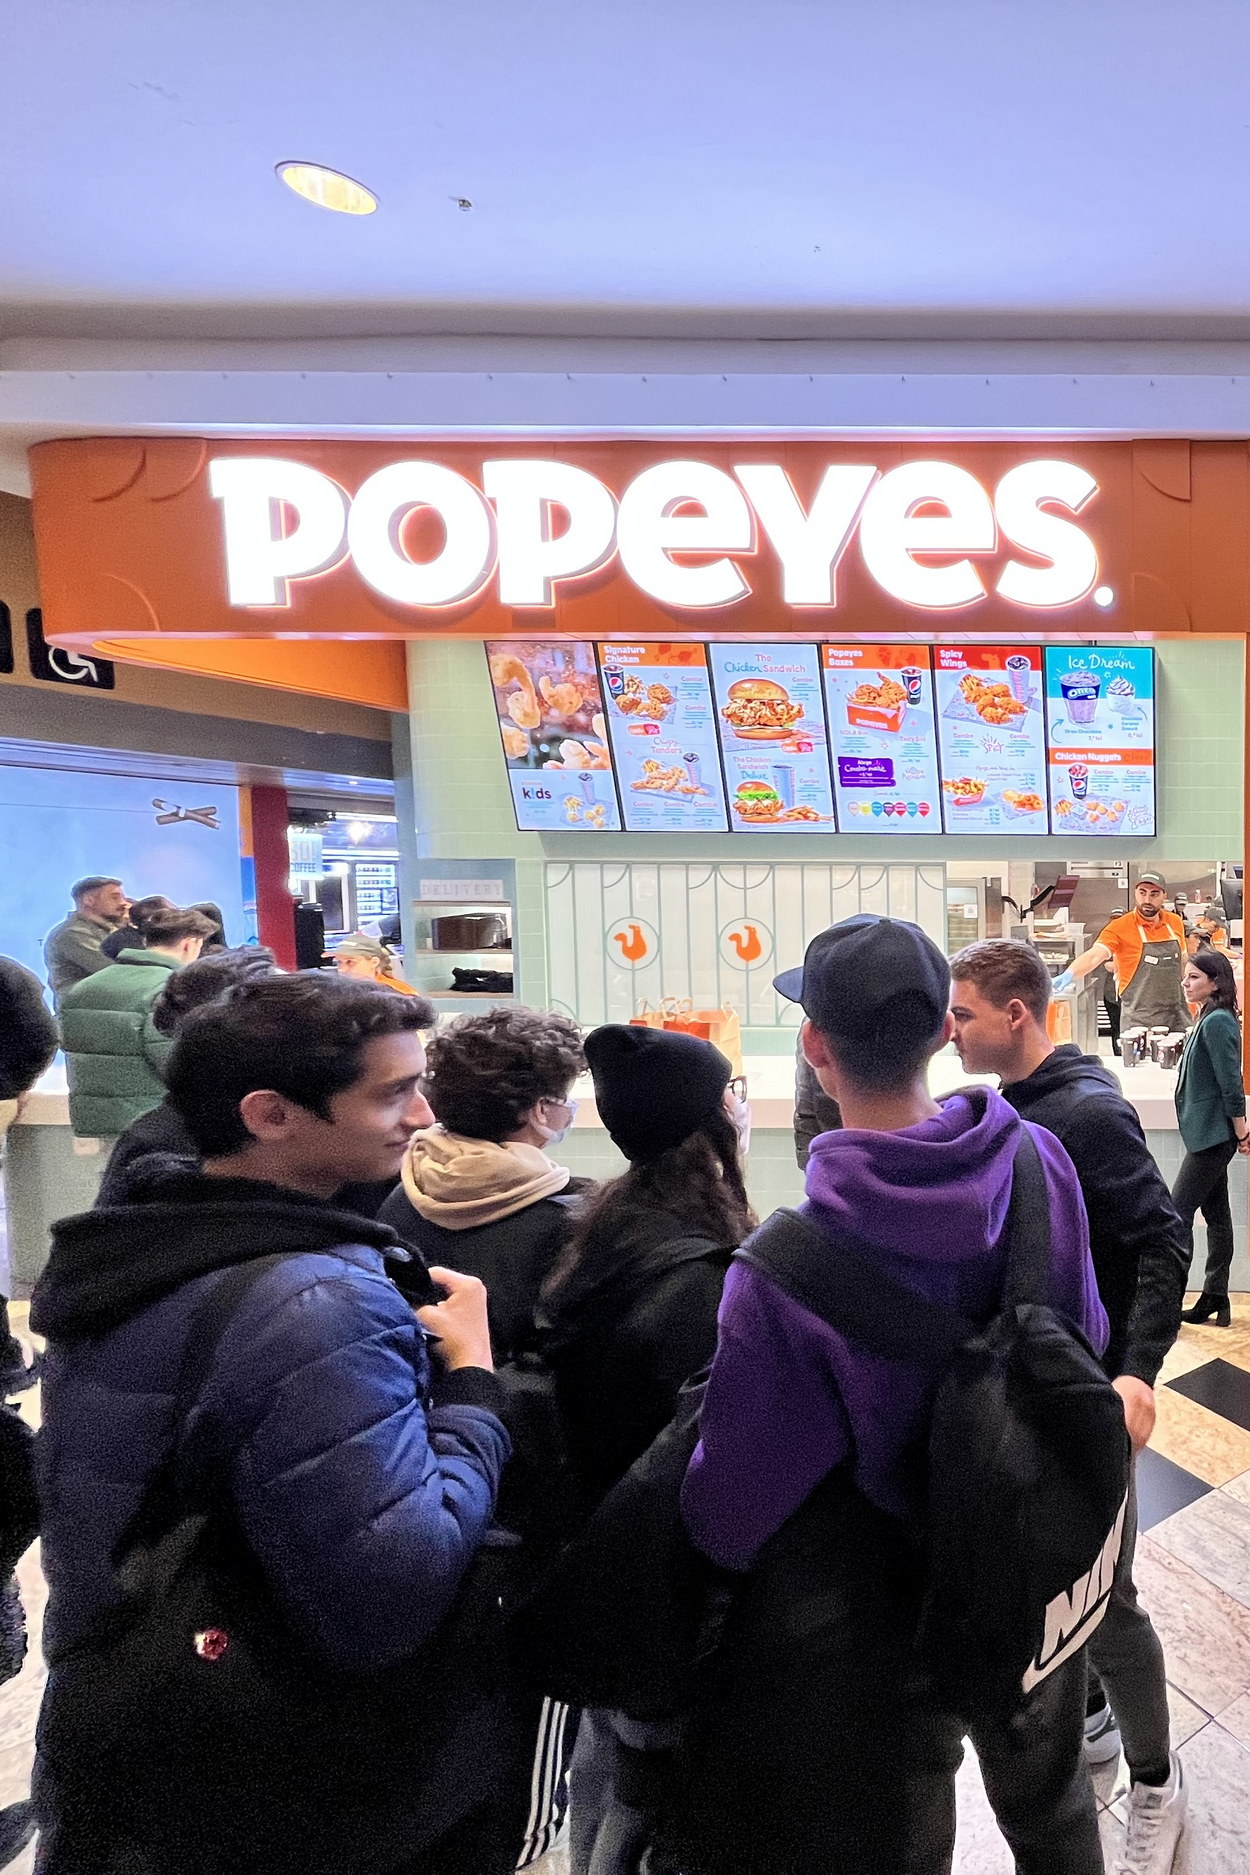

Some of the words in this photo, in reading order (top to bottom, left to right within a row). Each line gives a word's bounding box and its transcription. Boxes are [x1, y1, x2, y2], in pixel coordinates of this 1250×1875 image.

[603, 645, 646, 655] Signature
[828, 648, 863, 658] Popeyes
[939, 650, 963, 659] Spicy
[604, 655, 640, 664] Chicken
[755, 653, 772, 662] The
[1068, 655, 1087, 669] Ice
[1088, 653, 1136, 669] Dream
[724, 662, 763, 673] Chicken
[763, 665, 806, 673] Sandwich
[940, 659, 968, 668] Wings
[1068, 687, 1097, 699] OREO
[651, 746, 683, 754] Tenders
[1055, 752, 1088, 761] Chicken
[1087, 752, 1122, 762] Nuggets
[422, 884, 501, 896] DELIVERY
